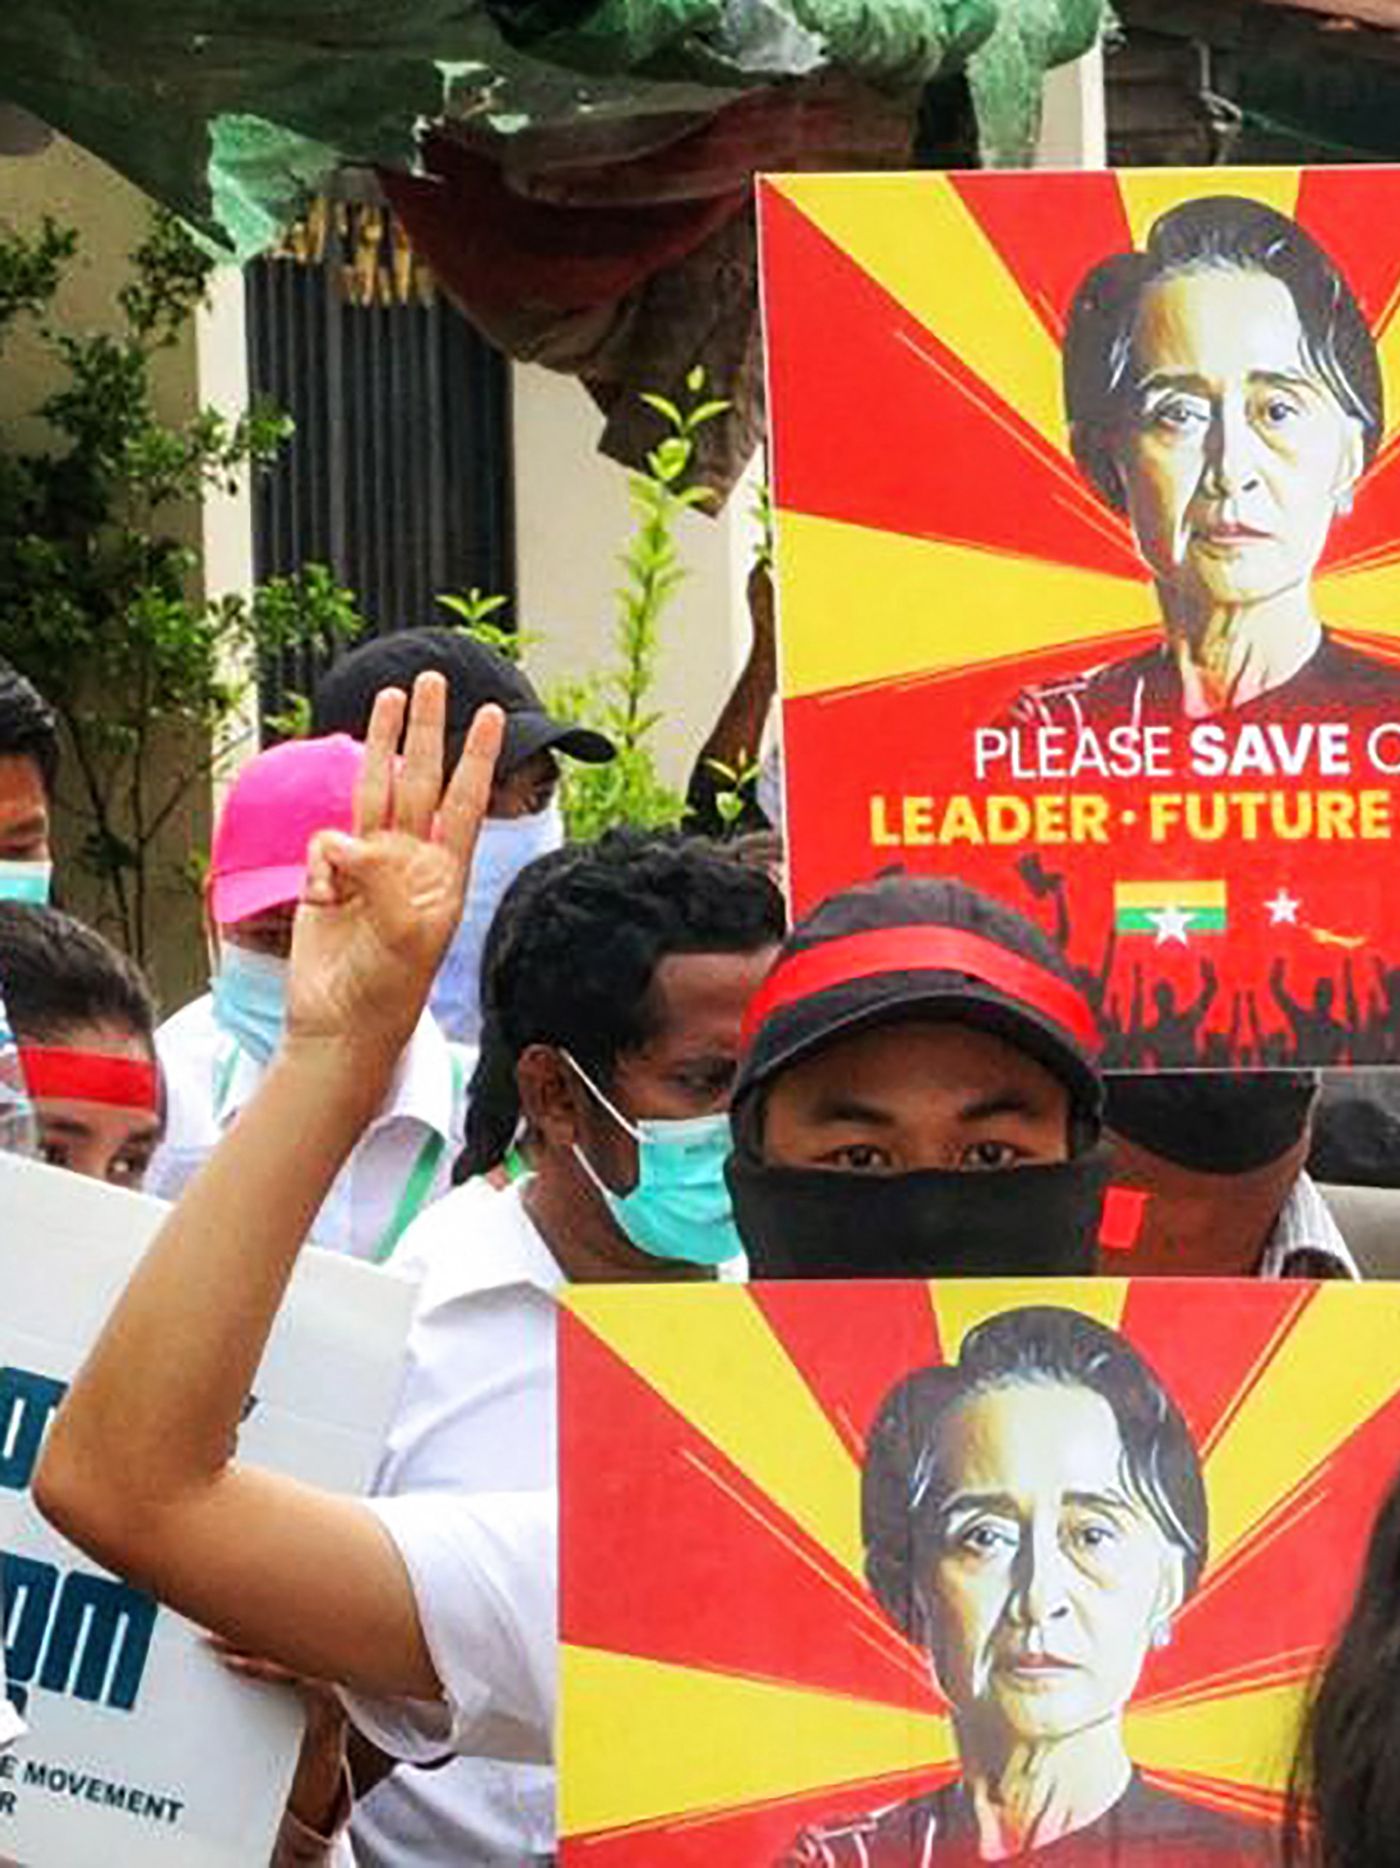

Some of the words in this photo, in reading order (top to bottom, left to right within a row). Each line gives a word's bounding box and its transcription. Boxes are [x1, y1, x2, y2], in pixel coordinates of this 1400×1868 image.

[975, 726, 1173, 779] PLEASE
[1190, 724, 1350, 777] SAVE
[869, 796, 1110, 846] LEADER
[1150, 790, 1391, 843] FUTURE
[22, 1761, 184, 1823] MOVEMENT
